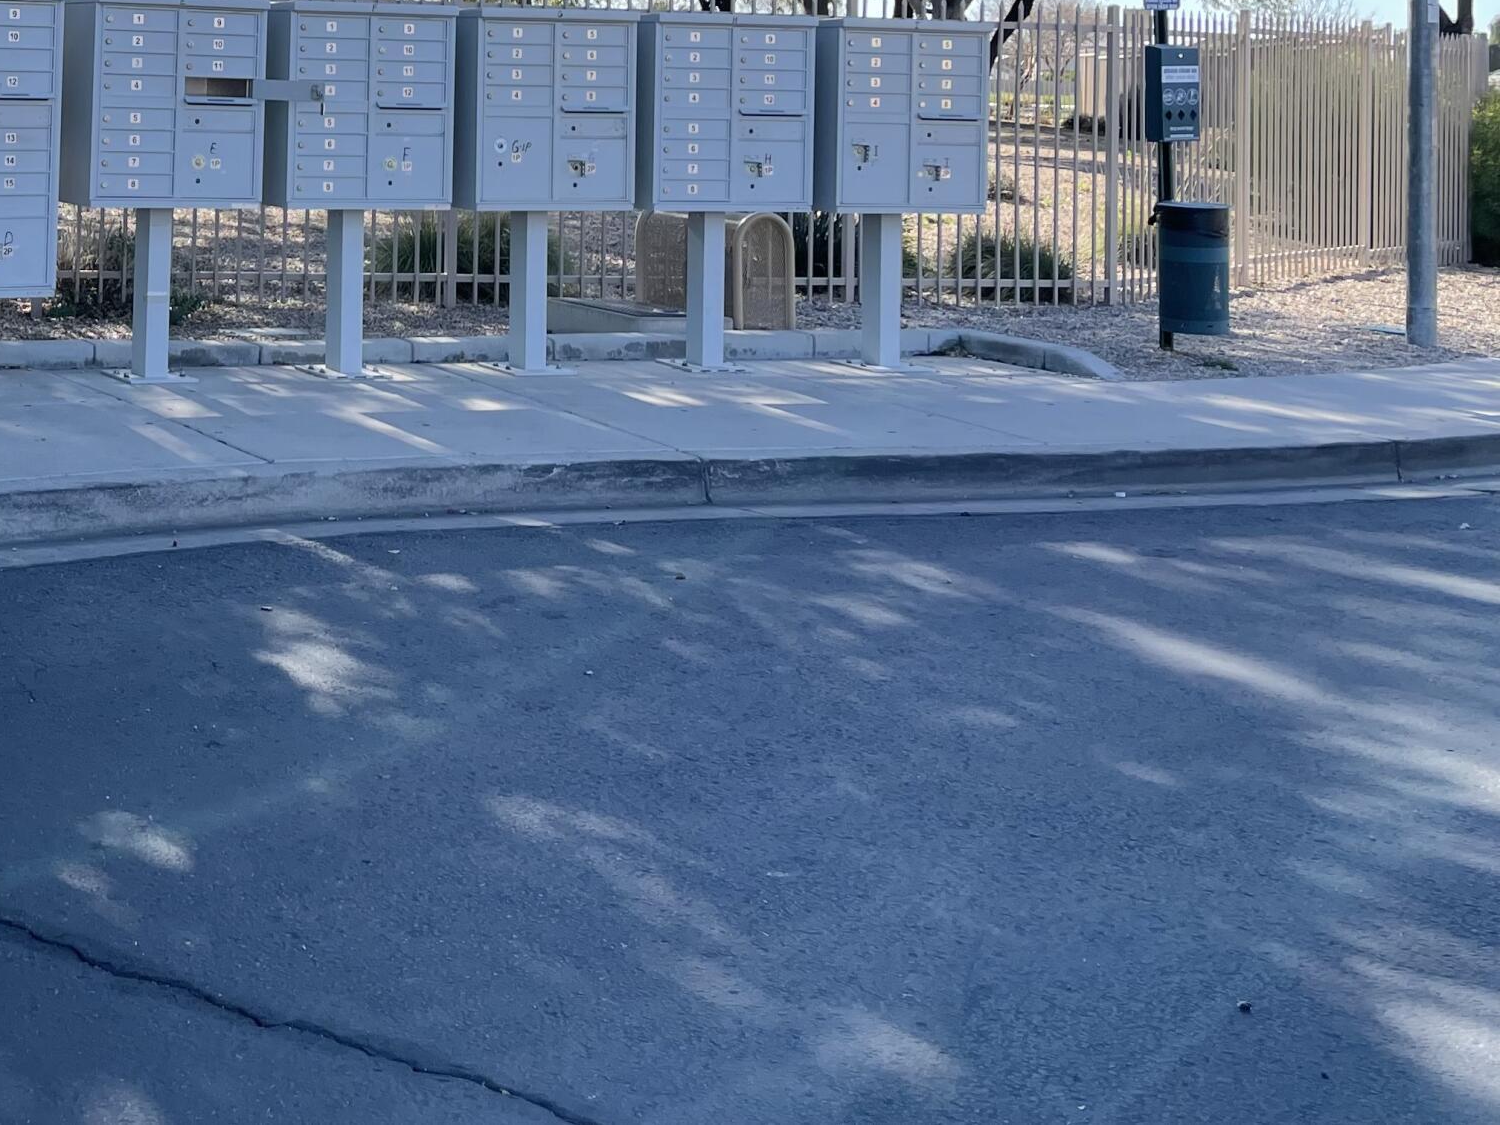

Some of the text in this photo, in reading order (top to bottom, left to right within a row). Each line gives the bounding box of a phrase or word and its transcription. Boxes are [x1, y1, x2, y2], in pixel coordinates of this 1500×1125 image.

[10, 32, 19, 41] 10
[214, 40, 223, 48] 10
[8, 77, 17, 86] 12
[7, 134, 15, 142] 13
[403, 147, 411, 161] F
[765, 154, 772, 164] H
[5, 179, 14, 187] 15
[4, 231, 13, 246] D
